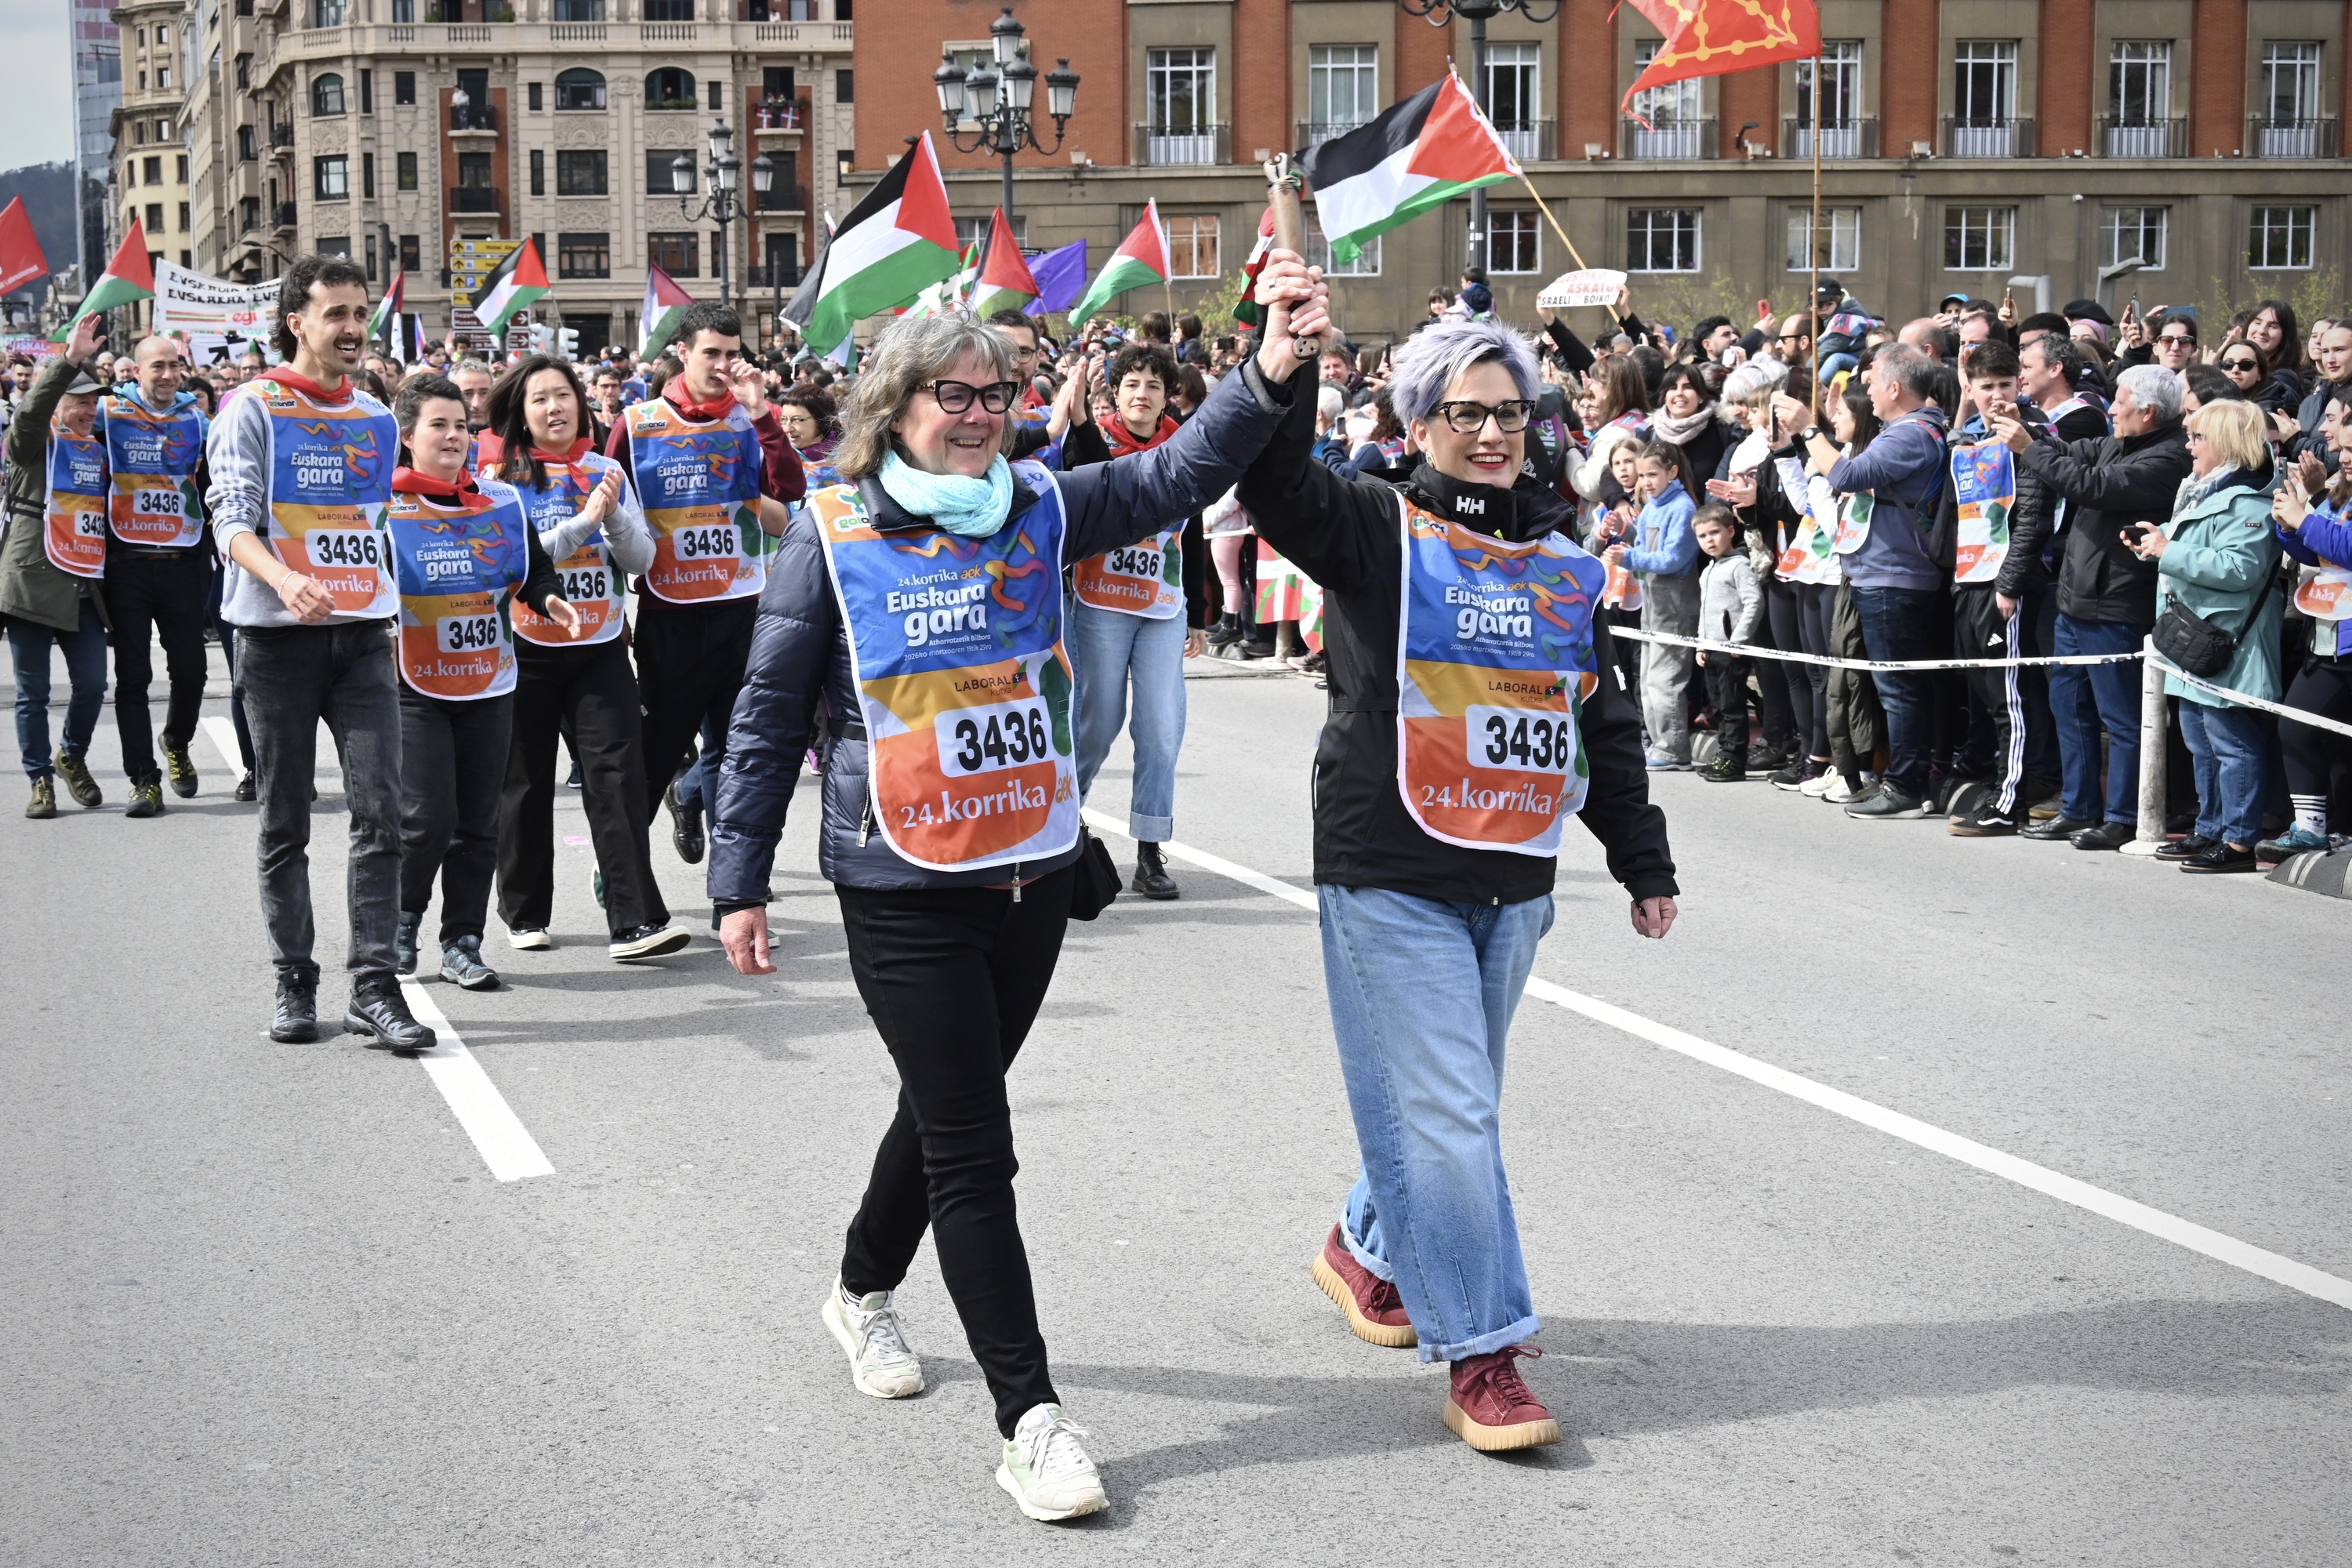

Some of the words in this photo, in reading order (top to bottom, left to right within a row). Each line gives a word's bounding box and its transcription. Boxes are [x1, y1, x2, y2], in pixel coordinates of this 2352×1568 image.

[232, 311, 257, 325] egi
[122, 441, 162, 452] Euskara
[297, 442, 328, 452] 24.korrika
[128, 450, 162, 464] gara
[291, 452, 343, 467] Euskara
[662, 454, 695, 464] 24.korrika
[73, 471, 100, 485] gara
[296, 467, 344, 489] gara
[656, 463, 707, 477] Euskara
[664, 474, 707, 495] gara
[1021, 471, 1044, 486] tb
[492, 488, 514, 497] eitb
[534, 495, 564, 506] 24.korrika
[141, 492, 180, 514] 3436
[531, 503, 573, 518] Euskara
[1456, 495, 1486, 514] HH
[117, 517, 176, 533] 24.korrika
[317, 534, 378, 565] 3436
[683, 528, 734, 557] 3436
[416, 548, 470, 562] Euskara
[1112, 548, 1160, 577] 3436
[426, 559, 473, 582] gara
[655, 564, 729, 586] 24.korrika
[736, 562, 757, 581] aek
[897, 568, 958, 587] 24.korrika
[960, 563, 982, 580] aek
[310, 572, 374, 593] orrika
[1507, 579, 1527, 592] aek
[887, 583, 986, 614] Euskara
[1082, 578, 1151, 601] 24.korrika
[1158, 590, 1177, 606] aek
[1445, 586, 1530, 614] Euskara
[450, 600, 483, 608] LABORAL
[904, 604, 987, 647] gara
[1456, 608, 1533, 640] gara
[448, 617, 497, 650] 3436
[928, 635, 971, 647] Atharratzetik
[971, 633, 991, 642] Bilbora
[1475, 636, 1514, 647] Atharratzetik
[904, 652, 927, 662] 2026ko
[929, 647, 965, 656] martxoaren
[1472, 646, 1506, 655] martxoaren
[413, 657, 493, 678] 24.korrika
[954, 675, 1011, 692] LABORAL
[1488, 681, 1543, 695] LABORAL
[990, 688, 1012, 697] kutxa
[1520, 695, 1543, 704] kutxa
[955, 707, 1047, 771] 3436
[1486, 715, 1568, 770] 3436
[901, 779, 1047, 829] 24.korrika
[1054, 764, 1074, 804] aek
[1421, 778, 1553, 815] 24.korrika
